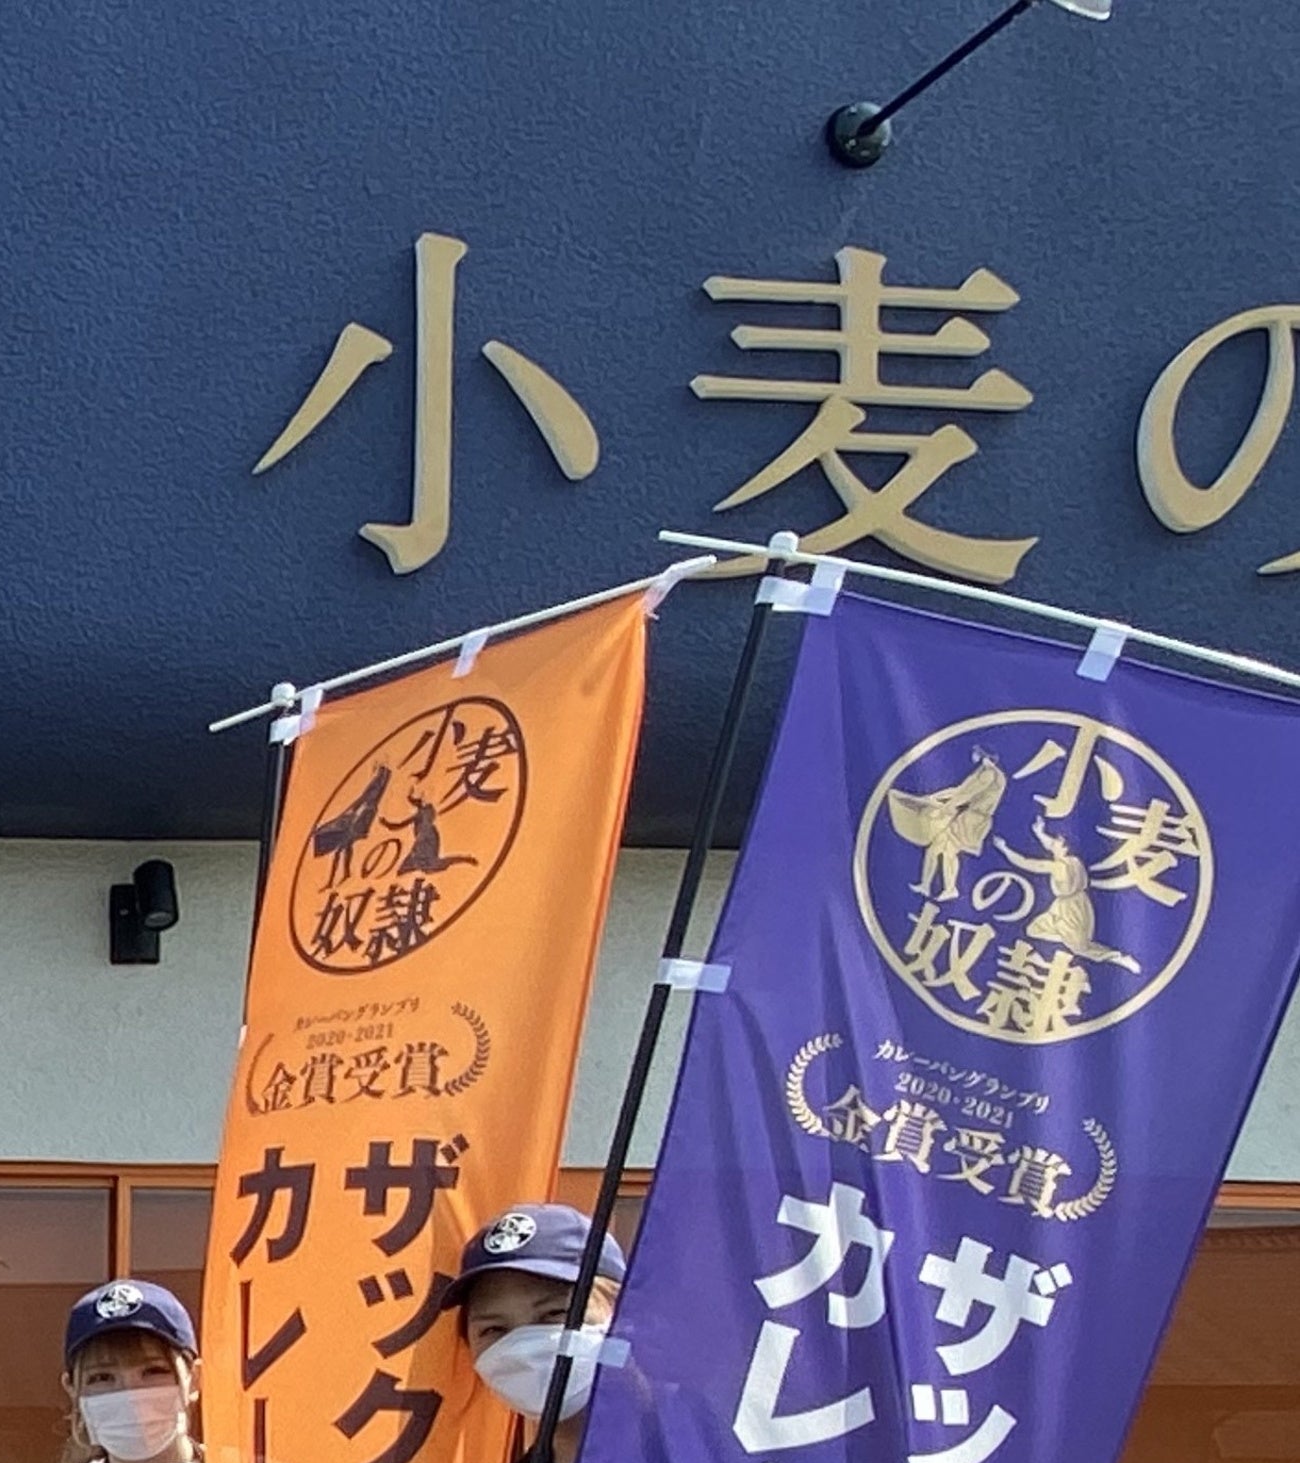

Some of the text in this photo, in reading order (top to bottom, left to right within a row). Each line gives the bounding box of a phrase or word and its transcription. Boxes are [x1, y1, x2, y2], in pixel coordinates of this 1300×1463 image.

[261, 1041, 449, 1114] 金賞受賞
[874, 1038, 1050, 1115] カレーパングランプリ
[823, 1083, 1073, 1219] 金賞受賞
